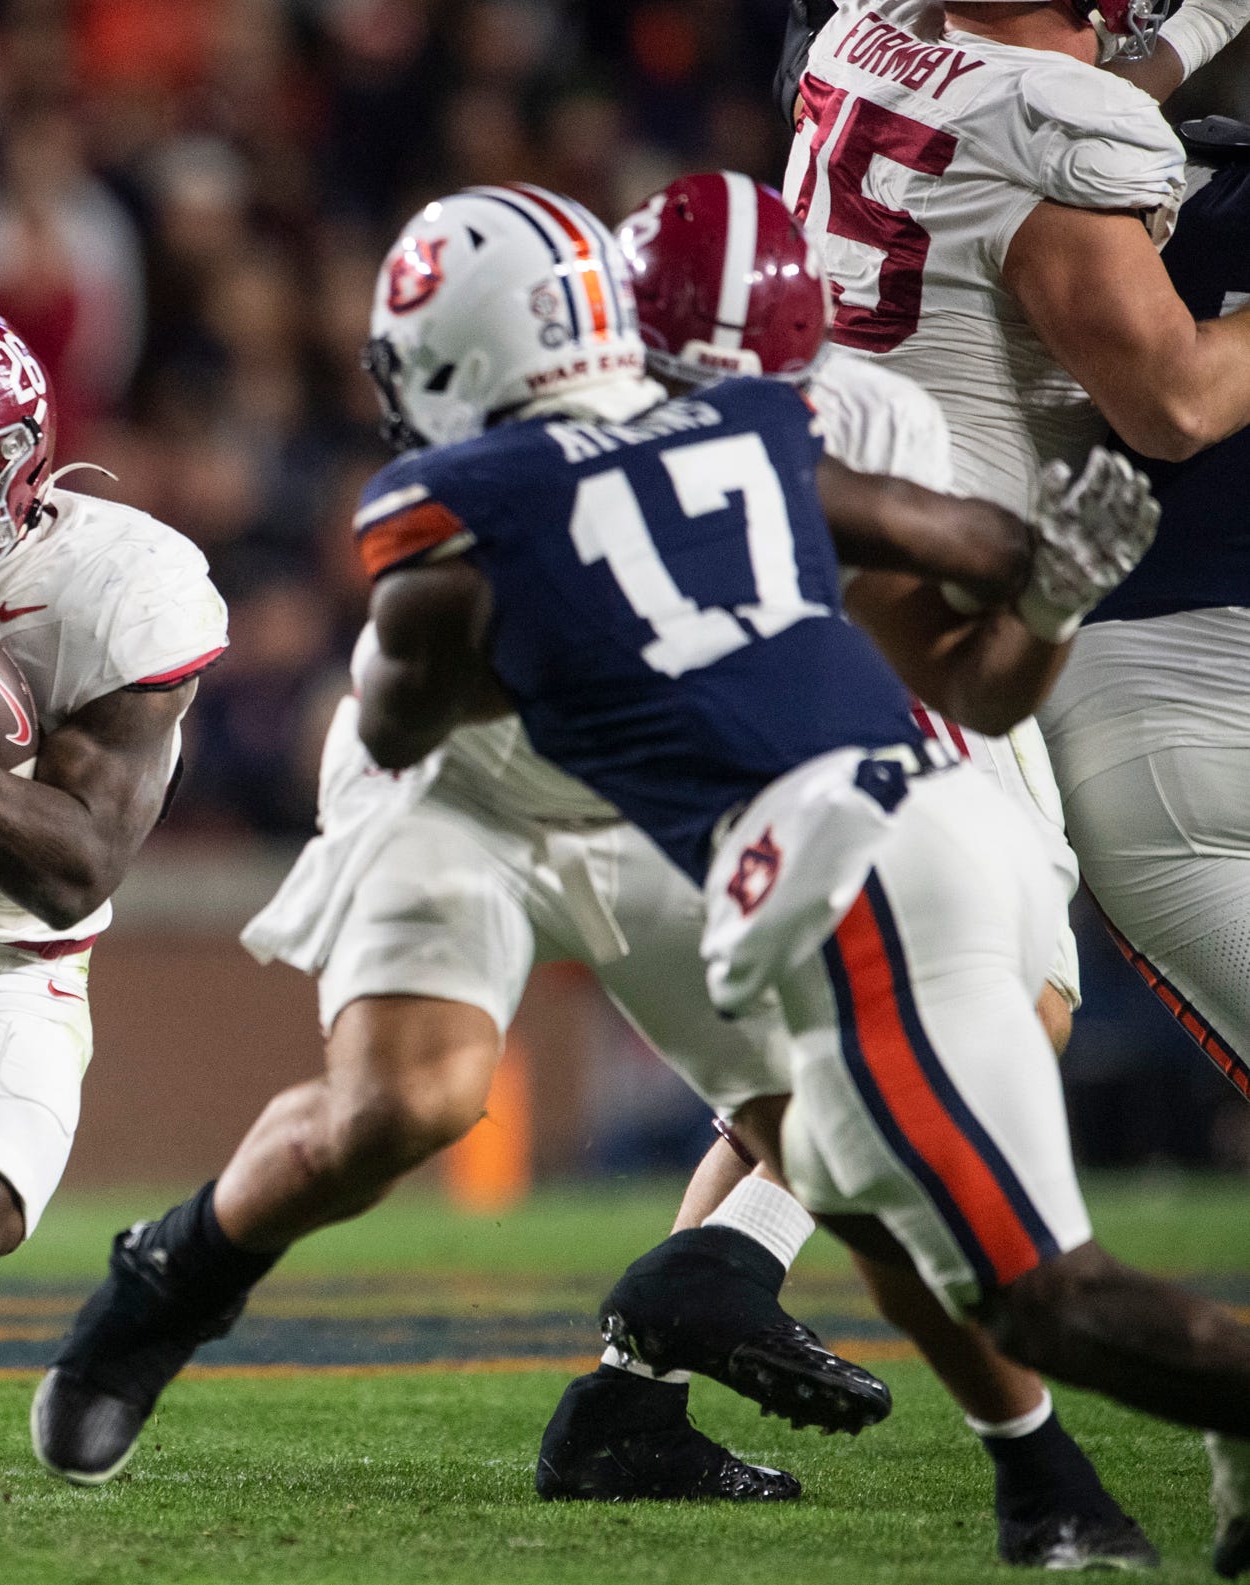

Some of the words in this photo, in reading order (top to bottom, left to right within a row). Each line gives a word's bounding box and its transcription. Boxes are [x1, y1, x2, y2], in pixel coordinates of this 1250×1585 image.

[833, 11, 986, 100] FORMBY
[795, 70, 959, 354] 75
[569, 430, 832, 680] 17
